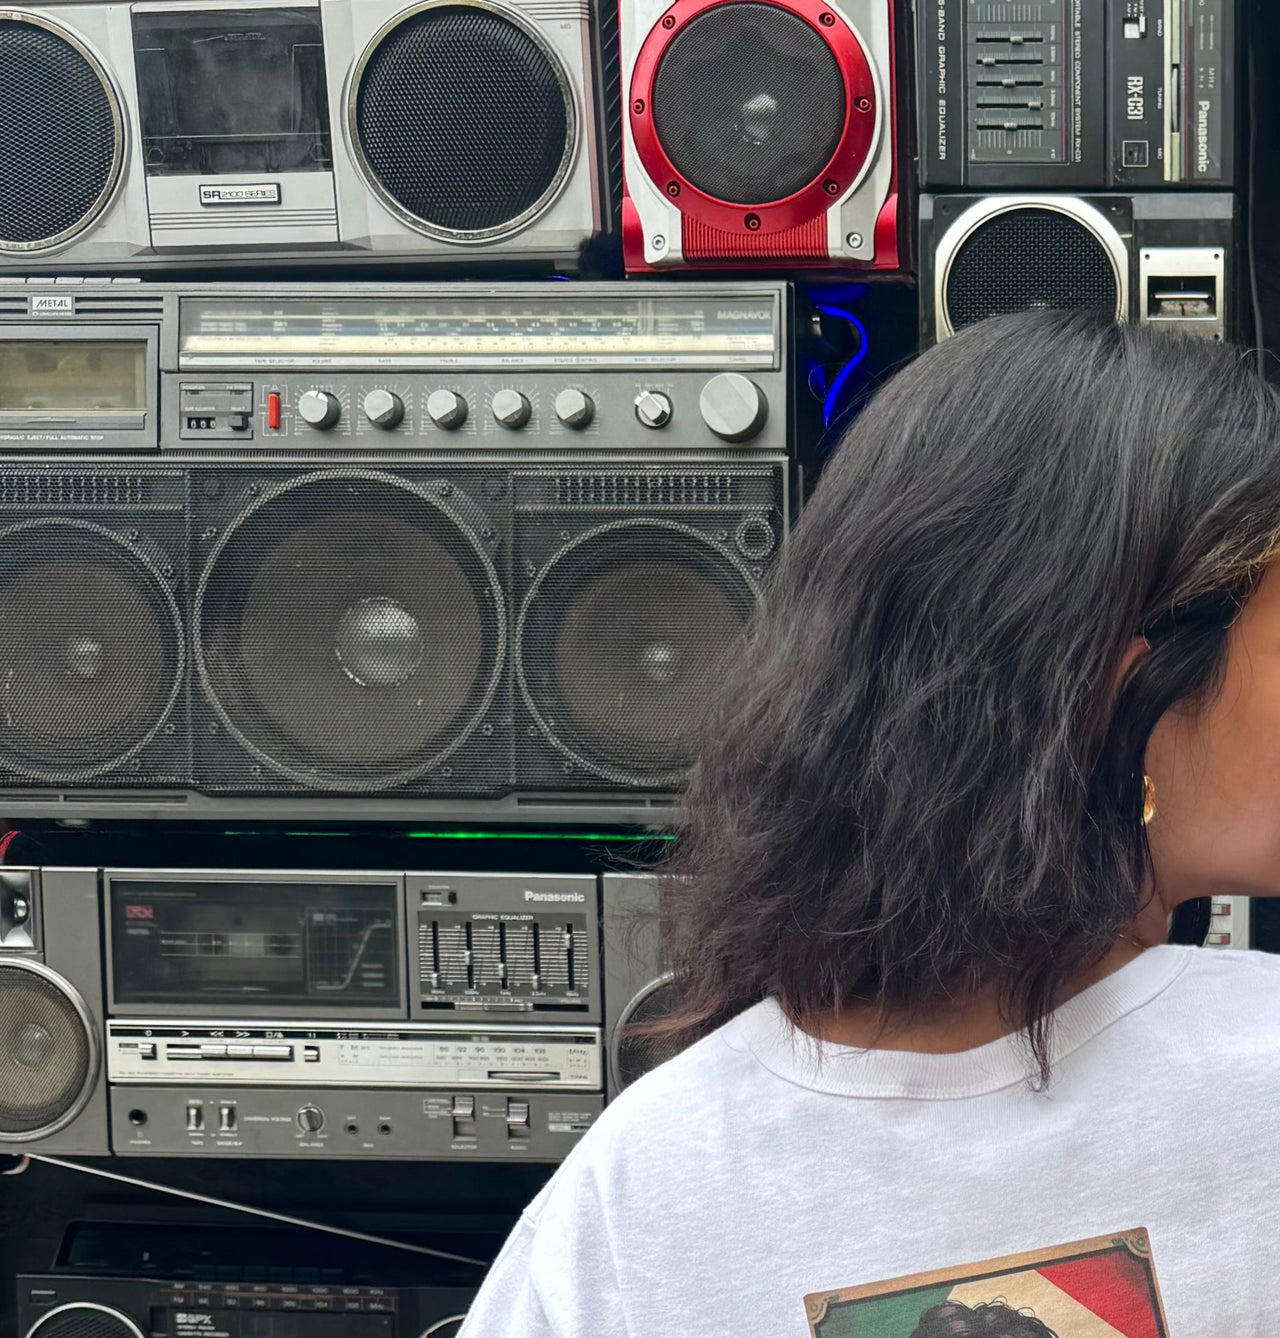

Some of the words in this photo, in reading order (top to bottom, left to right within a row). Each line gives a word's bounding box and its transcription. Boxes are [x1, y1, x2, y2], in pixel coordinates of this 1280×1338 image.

[937, 46, 946, 94] GRAPHIC
[1127, 76, 1143, 120] RX-C31
[937, 100, 946, 160] EQUALIZER
[1198, 101, 1210, 172] Panasonic
[203, 190, 220, 199] SR
[36, 299, 68, 308] METAL
[717, 310, 771, 320] MAGNAVOX
[525, 890, 585, 902] Panasonic
[187, 1313, 212, 1324] GPX
